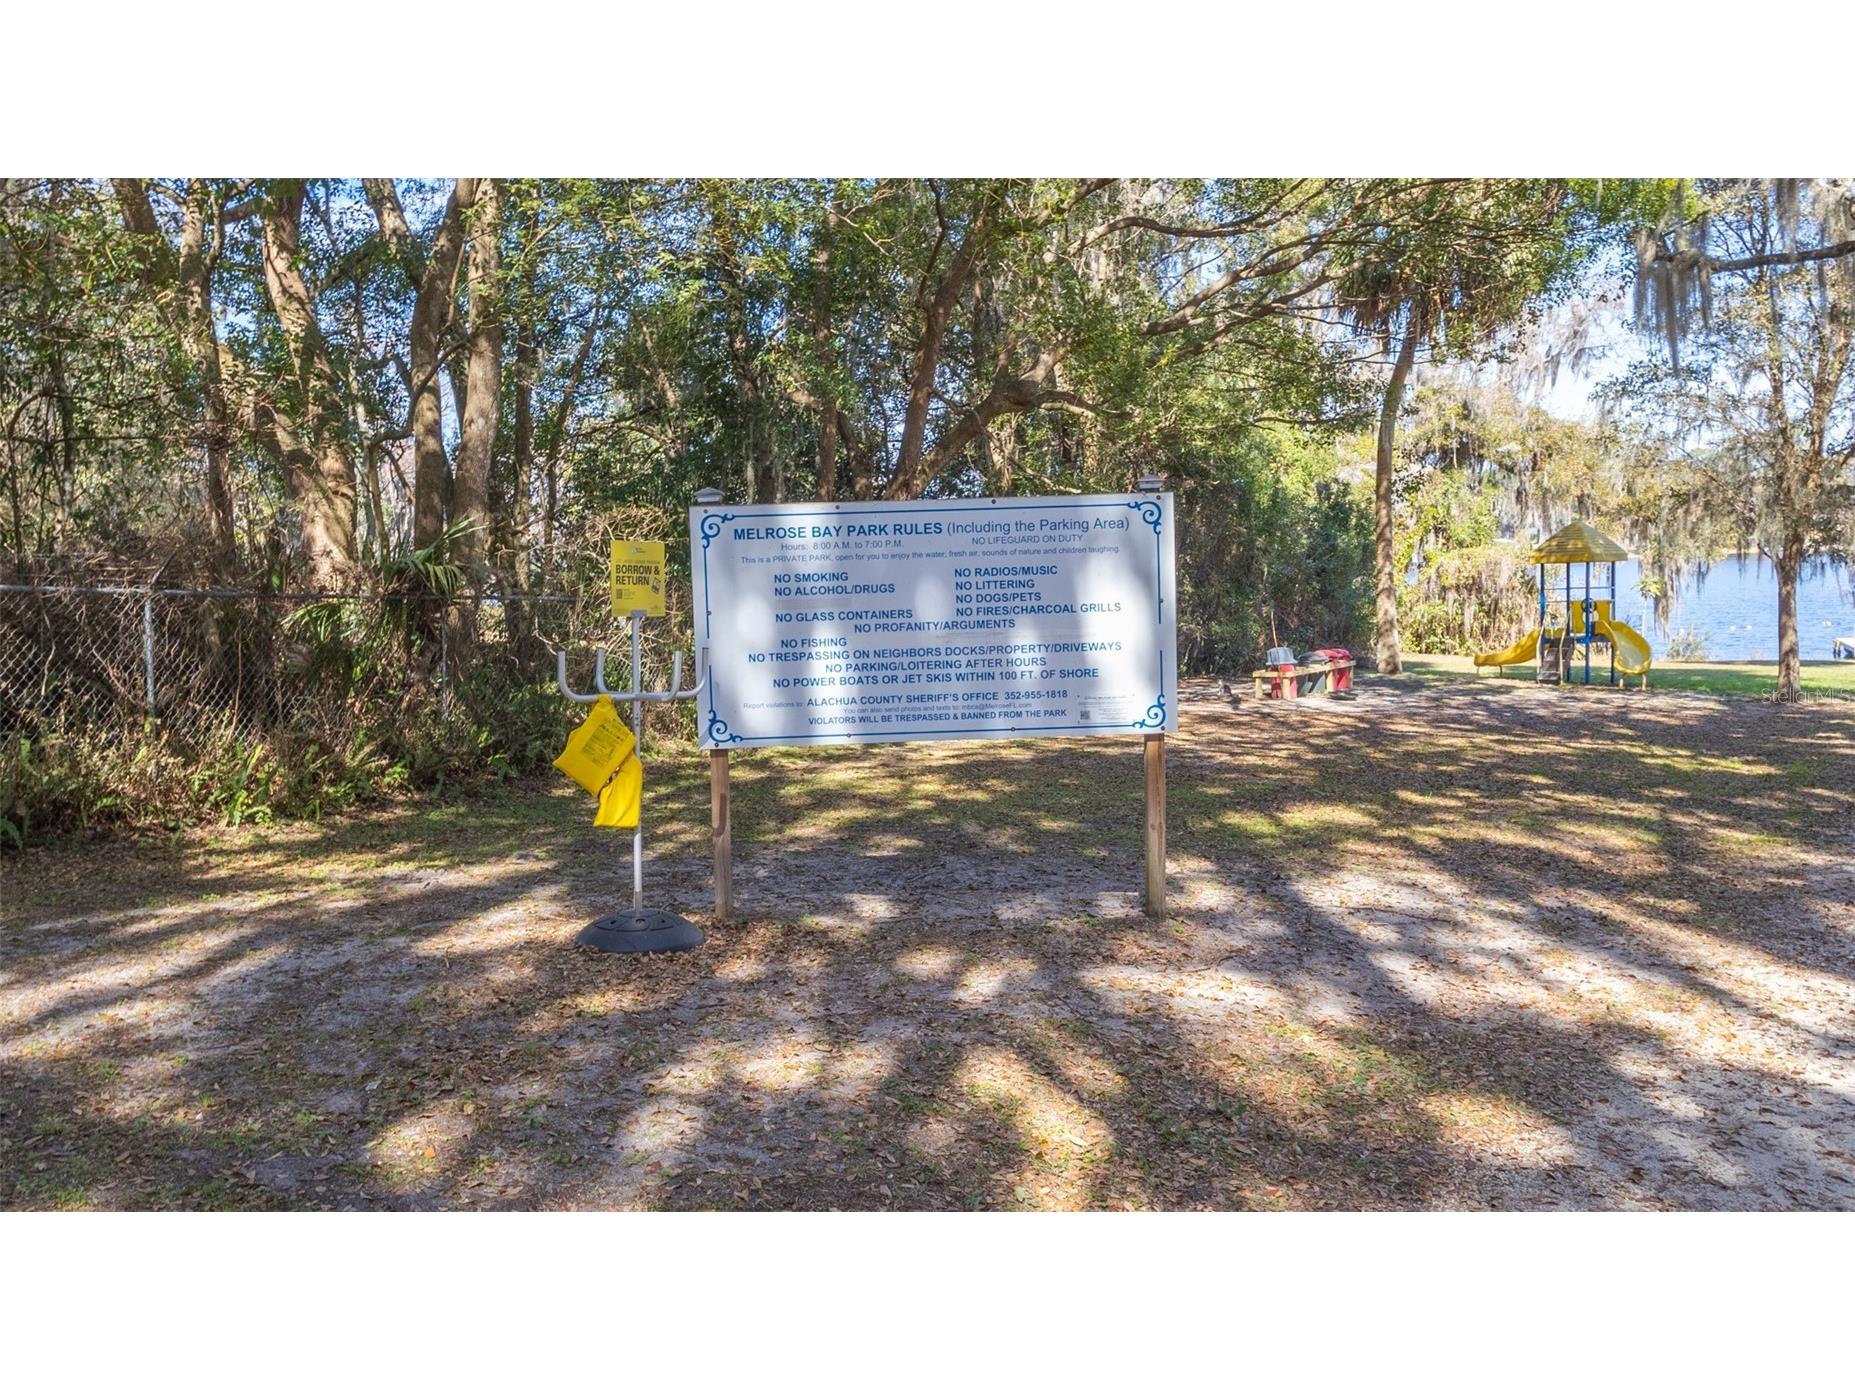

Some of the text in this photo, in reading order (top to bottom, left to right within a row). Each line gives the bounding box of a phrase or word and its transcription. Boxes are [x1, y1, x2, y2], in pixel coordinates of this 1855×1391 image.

[733, 517, 1130, 541] MELROSE BAY PARK RULES (Including the Parking Area)
[781, 543, 808, 551] Hours:
[813, 542, 832, 550] 8:00
[854, 541, 863, 549] to
[865, 540, 883, 548] 7:00
[885, 539, 904, 547] P.M.
[971, 533, 1084, 545] NO LIFEGUARD ON DUTY
[741, 556, 756, 564] This
[772, 554, 807, 562] PRIVATE
[835, 554, 854, 562] open
[866, 553, 880, 561] you
[891, 552, 911, 560] enjoy
[912, 551, 922, 559] the
[982, 548, 1008, 556] sounds
[1043, 547, 1057, 555] and
[1058, 546, 1087, 554] children
[615, 564, 660, 575] BORROW &
[954, 565, 1058, 578] NO RADIOS/MUSIC
[615, 575, 650, 586] RETURN
[774, 571, 849, 584] NO SMOKING
[955, 578, 1035, 591] NO LITTERING
[774, 583, 895, 597] NO ALCOHOL/DRUGS
[955, 591, 1042, 604] NO DOGS/PETS
[775, 609, 913, 623] NO GLASS CONTAINERS
[956, 602, 1121, 617] NO FIRES/CHARCOAL GRILLS
[854, 618, 1016, 633] NO PROFANITY/ARGUMENTS
[781, 637, 847, 649] NO FISHING
[748, 641, 1122, 663] NO TRESPASSING ON NEIGHBORS DOCKS/PROPERTY/DRIVEWAYS
[825, 656, 1047, 673] NO PARKING/LOITERING AFTER HOURS
[773, 667, 1099, 689] NO POWER BOATS OR JET SKIS WITHIN 100 FT. OF SHORE
[807, 696, 858, 707] ALACHUA
[860, 695, 903, 705] COUNTY
[905, 693, 960, 704] SHERIFF'S
[961, 691, 999, 702] OFFICE
[1004, 689, 1068, 700] 352-955-1818
[900, 705, 922, 713] photos
[808, 709, 1067, 726] VIOLATORS WILL BE TRESPASSED & BANNED FROM THE PARK
